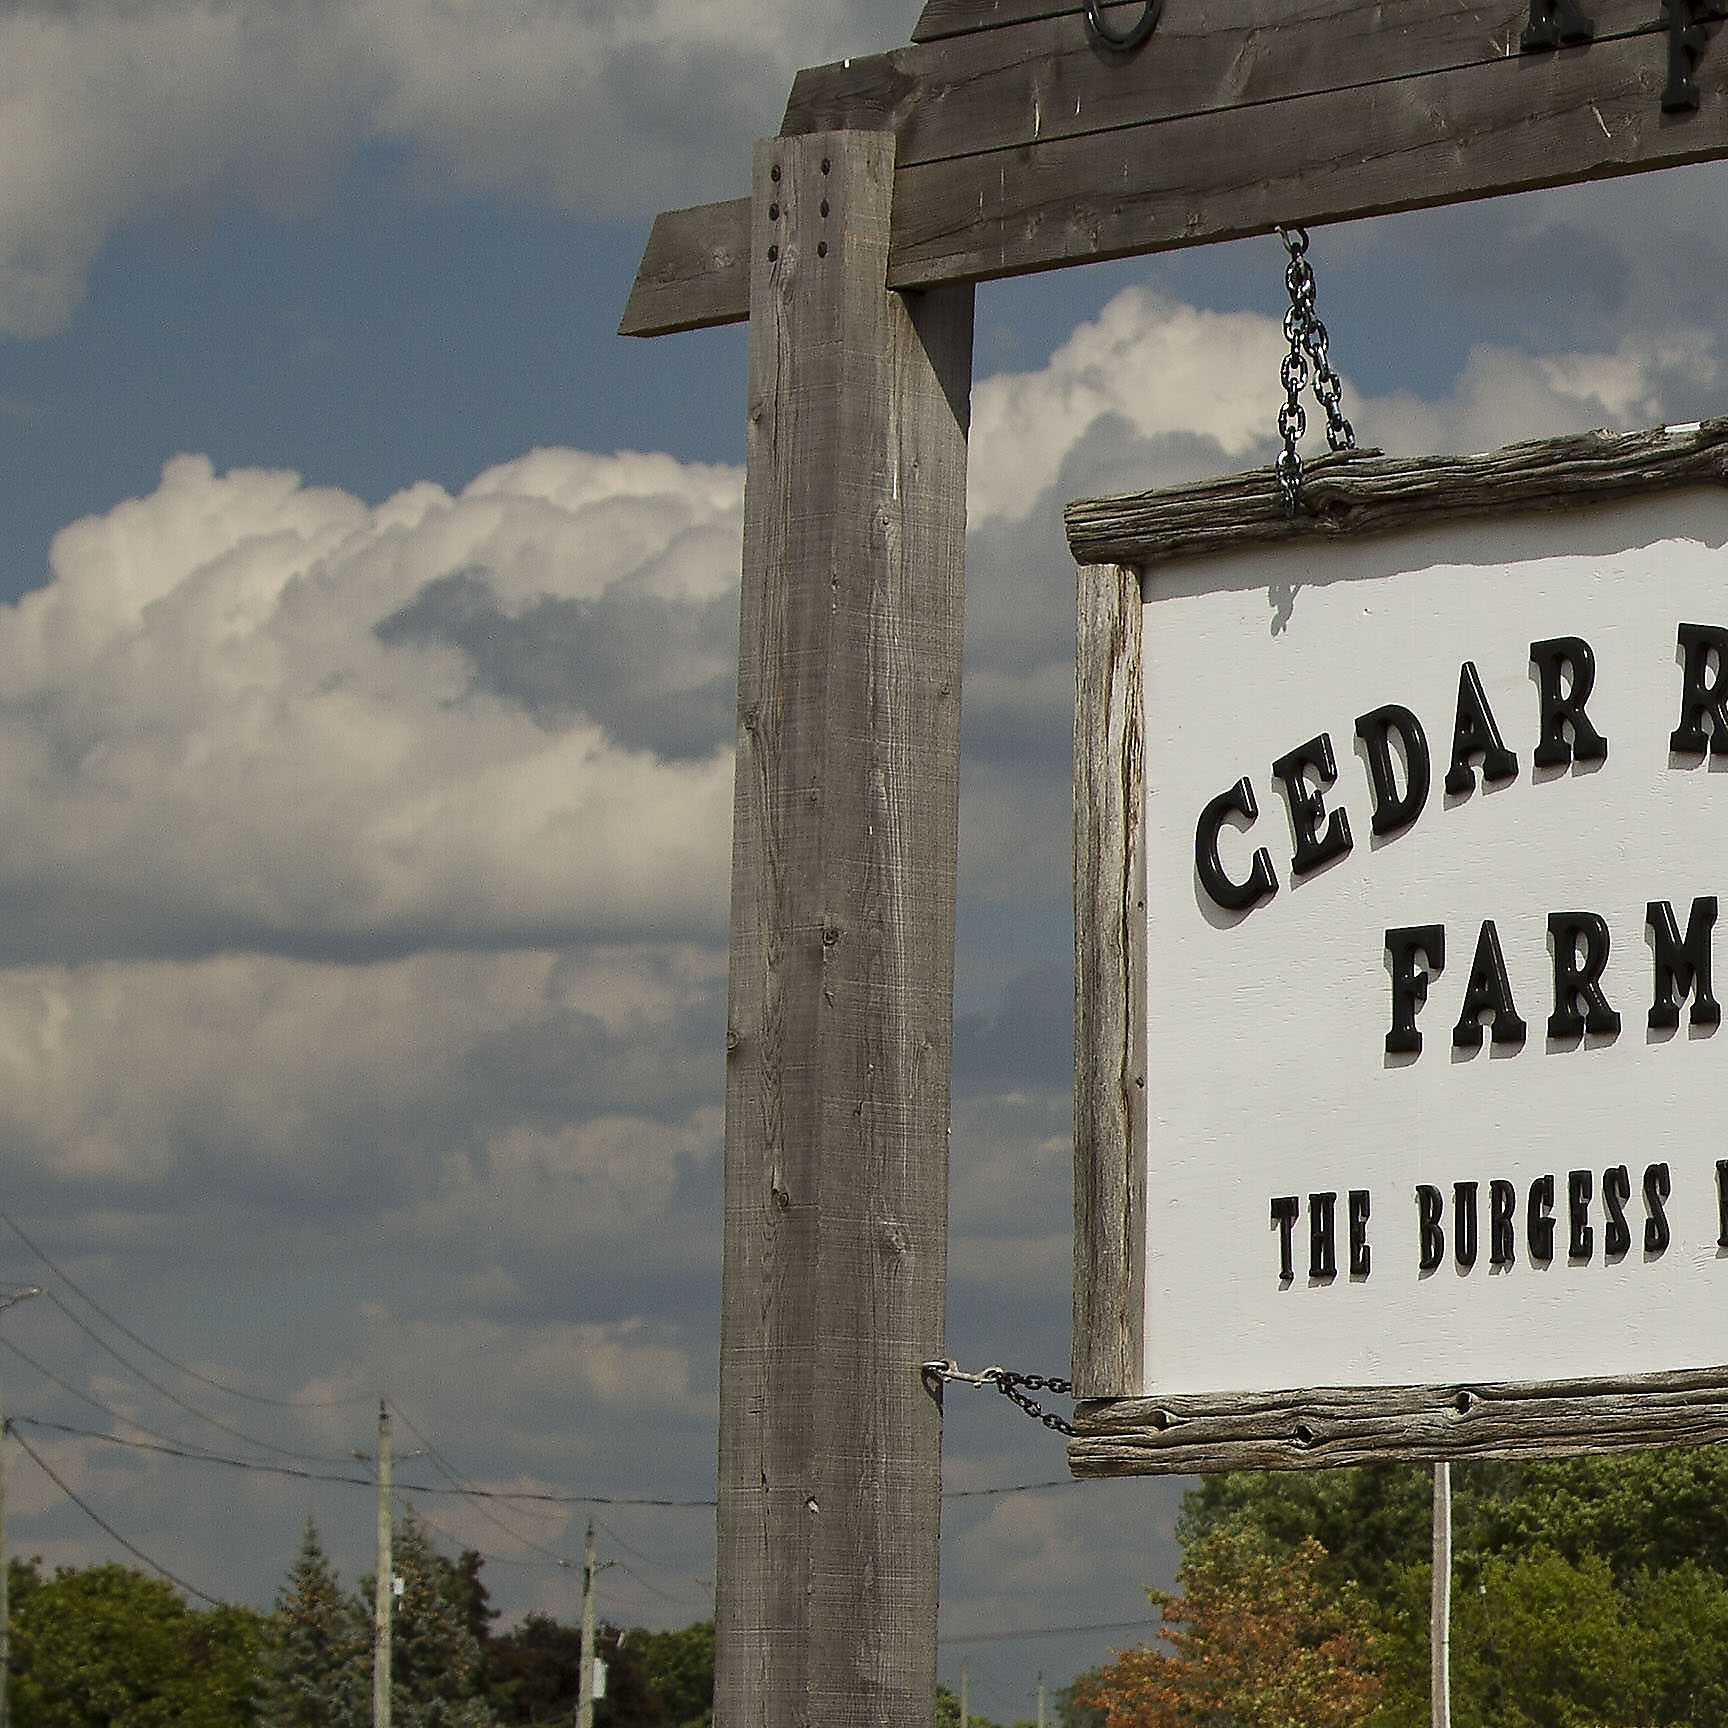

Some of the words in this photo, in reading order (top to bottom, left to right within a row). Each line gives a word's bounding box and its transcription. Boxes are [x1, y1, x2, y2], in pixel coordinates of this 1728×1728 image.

[1194, 636, 1608, 911] CEDAR
[1270, 1189, 1371, 1280] THE
[1415, 1162, 1671, 1271] BURGESS
